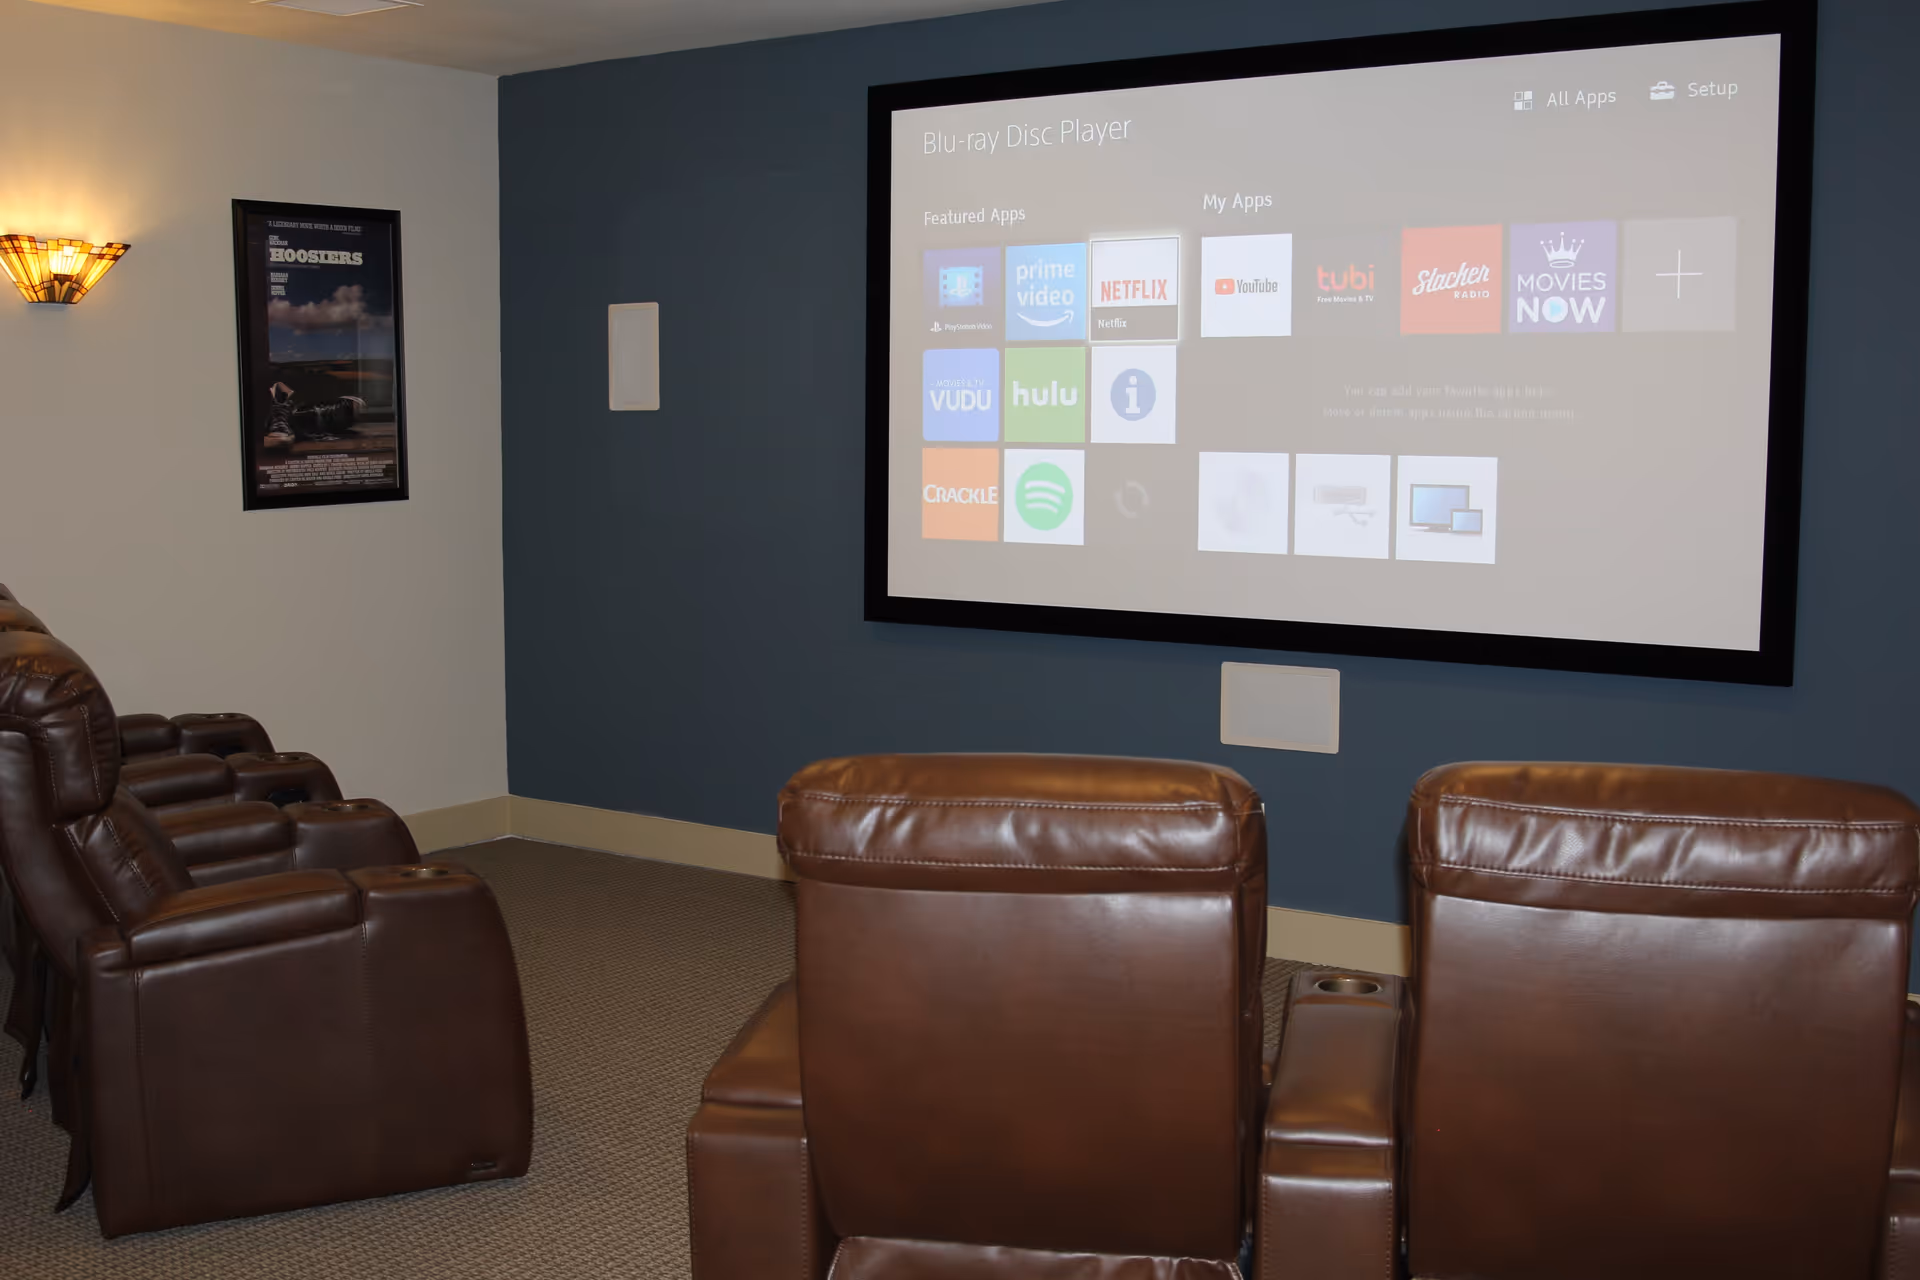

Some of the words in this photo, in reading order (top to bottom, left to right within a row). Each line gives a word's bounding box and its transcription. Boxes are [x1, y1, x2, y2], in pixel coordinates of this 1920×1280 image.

[1546, 90, 1569, 107] All
[1575, 90, 1617, 109] Apps
[1688, 81, 1738, 99] Setup
[923, 129, 1000, 154] Blu-ray
[1006, 123, 1054, 147] Disc
[1060, 118, 1132, 146] Player
[1202, 193, 1227, 214] My
[1232, 192, 1273, 214] Apps
[924, 207, 985, 226] Featured
[990, 207, 1025, 226] Apps
[269, 247, 364, 266] HOOSIERS
[1016, 259, 1075, 285] prime
[1316, 263, 1375, 292] tubi
[1411, 262, 1490, 296] Slacker
[1517, 271, 1607, 292] MOVIES
[1016, 284, 1076, 307] video
[1100, 279, 1168, 302] NETFLIX
[1236, 277, 1278, 293] YouTube
[1454, 290, 1490, 299] RADIO
[1515, 295, 1607, 324] NOW
[1098, 317, 1127, 329] Netflix
[929, 389, 992, 411] VUDU
[1012, 380, 1078, 407] hulu
[922, 484, 999, 505] CRACKLE
